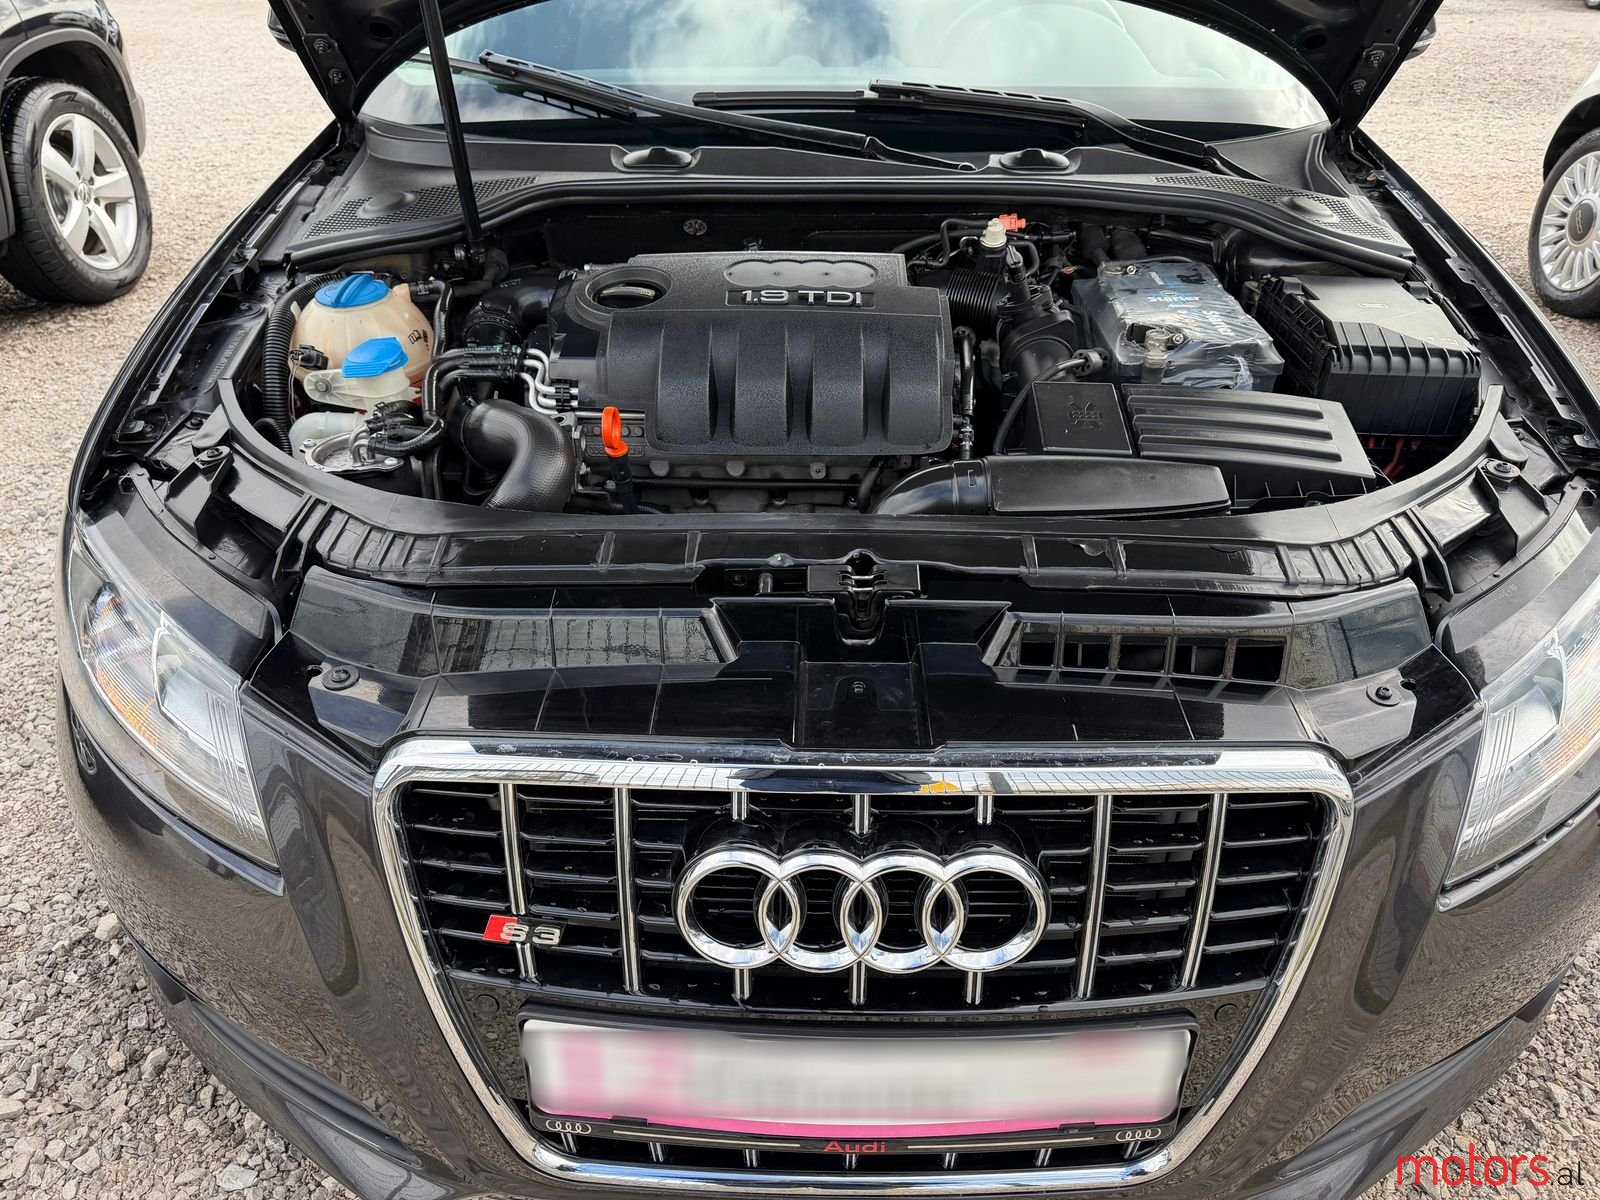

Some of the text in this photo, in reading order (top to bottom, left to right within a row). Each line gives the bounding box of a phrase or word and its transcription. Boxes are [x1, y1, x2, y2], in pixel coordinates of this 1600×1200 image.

[741, 289, 863, 307] 1.9 TDI
[500, 921, 561, 946] S3
[823, 1140, 887, 1153] Audi
